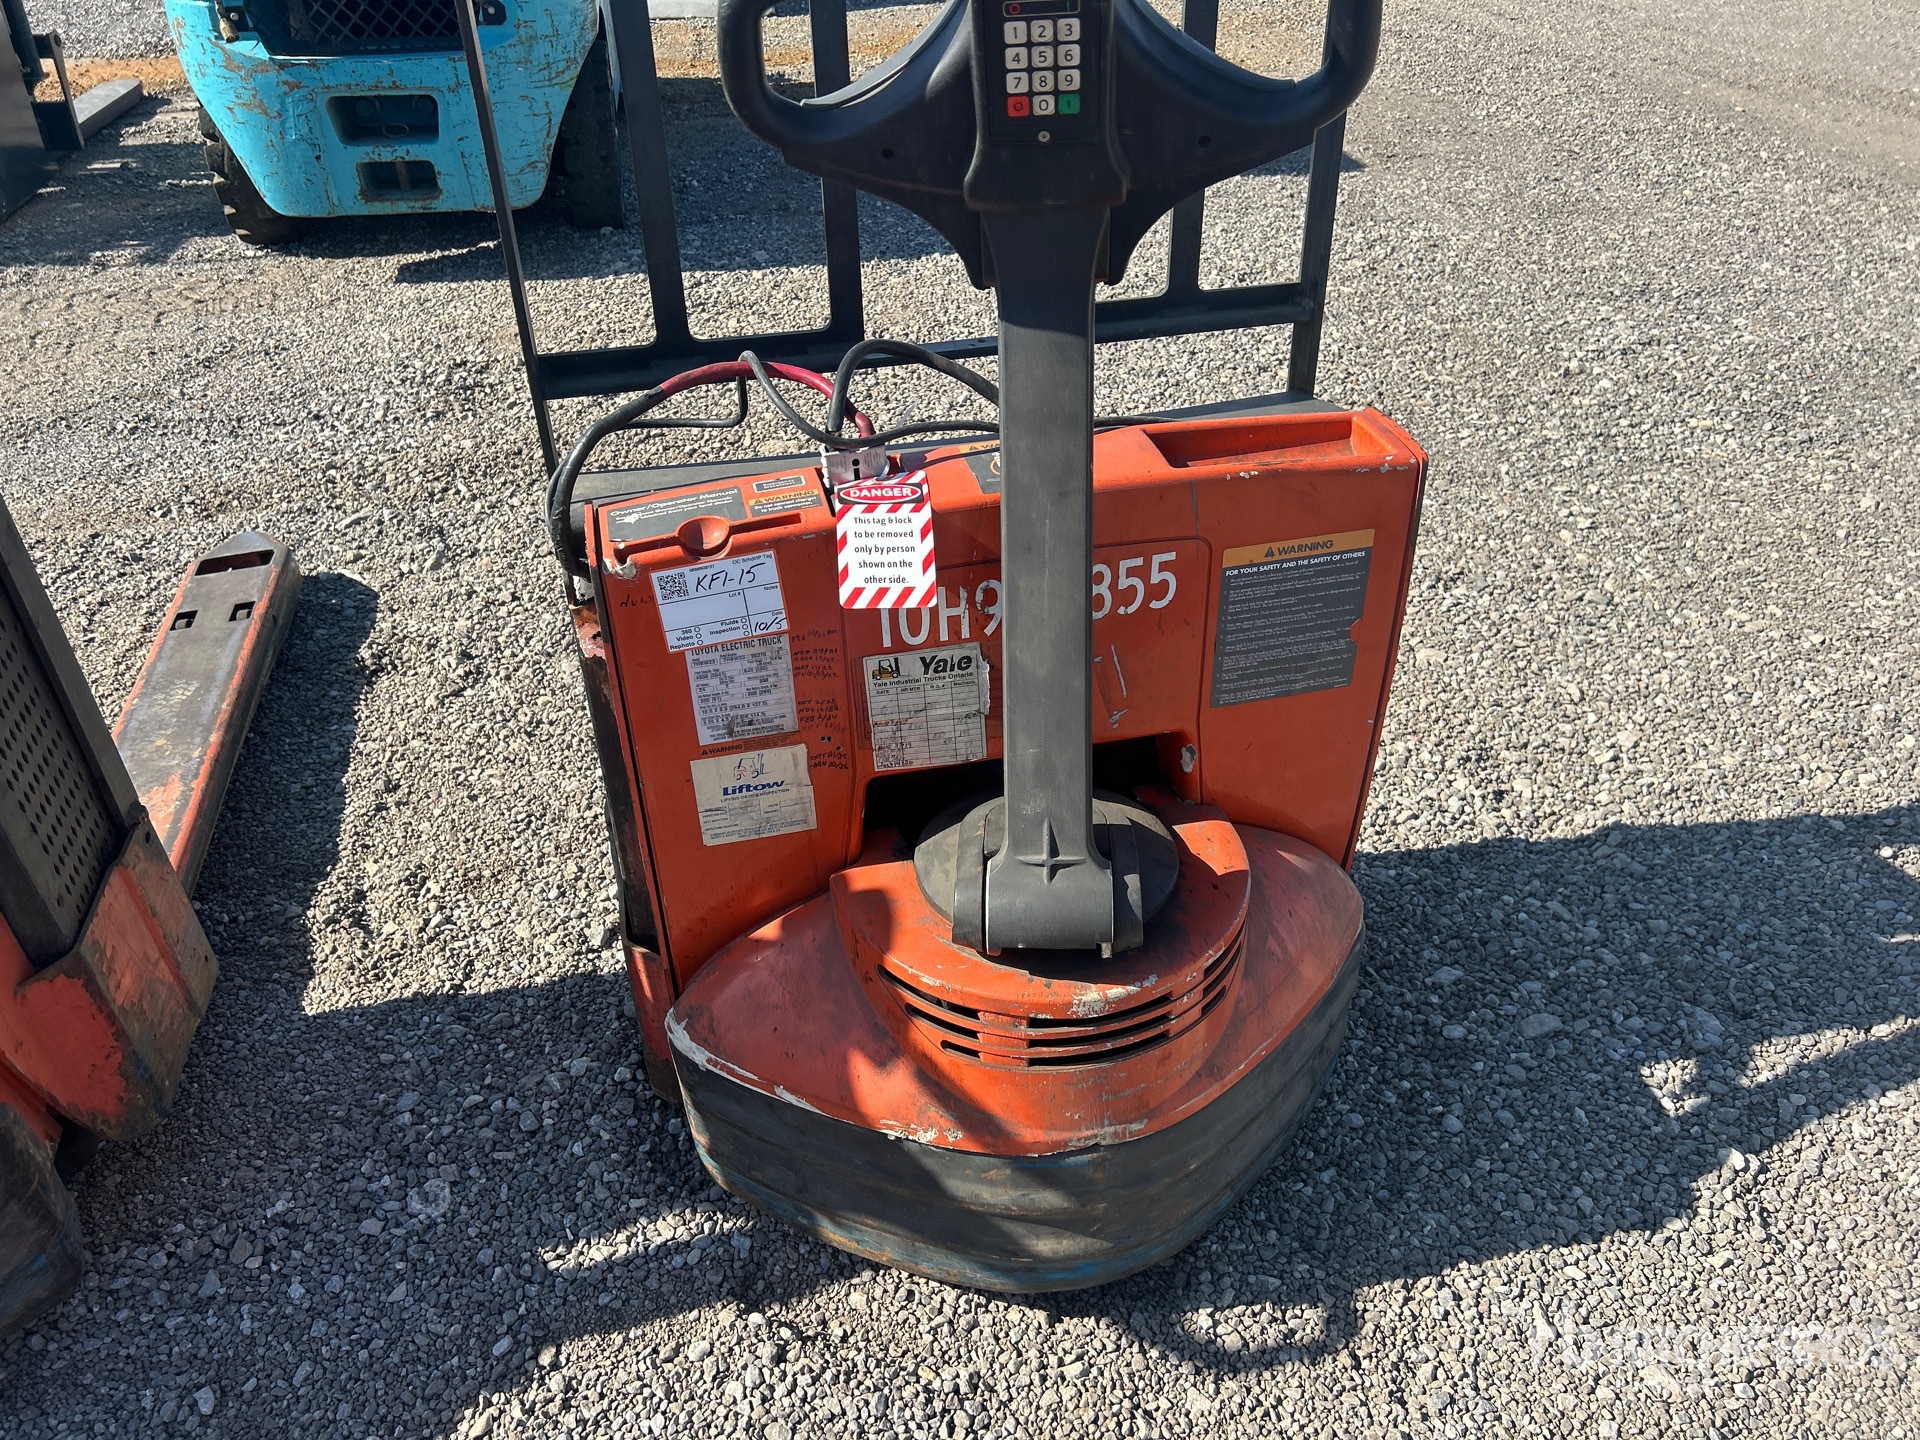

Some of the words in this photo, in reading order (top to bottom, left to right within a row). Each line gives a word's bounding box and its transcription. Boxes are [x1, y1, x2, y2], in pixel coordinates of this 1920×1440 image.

[1013, 26, 1018, 40] 1
[1038, 25, 1046, 38] 2
[1064, 24, 1073, 36] 3
[1012, 52, 1021, 64] 4
[1038, 51, 1048, 63] 5
[1064, 49, 1073, 62] 6
[1013, 77, 1022, 89] 7
[1039, 76, 1048, 88] 8
[1064, 74, 1073, 86] 9
[1038, 100, 1048, 112] 0
[764, 490, 816, 502] WARNING
[850, 488, 912, 498] DANGER
[610, 495, 698, 516] Owner/Operator
[699, 488, 738, 500] Manual
[872, 517, 886, 526] tag
[895, 516, 912, 524] lock
[854, 530, 863, 538] to
[864, 530, 875, 538] be
[876, 530, 914, 538] removed
[854, 544, 872, 555] only
[874, 544, 884, 555] by
[886, 546, 916, 554] person
[1278, 540, 1334, 556] WARNING
[858, 560, 886, 568] shown
[899, 560, 912, 568] the
[1240, 566, 1258, 574] YOUR
[1259, 563, 1281, 572] SAFETY
[1282, 560, 1296, 568] AND
[1298, 558, 1309, 566] THE
[1309, 555, 1330, 564] SAFETY
[1342, 550, 1366, 560] OTHERS
[864, 575, 886, 584] other
[888, 575, 909, 584] side.
[720, 619, 739, 627] Fluids
[754, 616, 788, 633] 10/5
[710, 626, 740, 636] Inspection
[670, 640, 696, 651] Rephoto
[690, 644, 720, 656] TOYOTA
[721, 639, 756, 652] ELECTRIC
[756, 636, 783, 646] TRUCK
[918, 654, 972, 676] Yale
[888, 678, 922, 686] Industrial
[948, 672, 974, 680] Ontario
[708, 744, 742, 754] WARNING
[722, 780, 785, 796] Liftow
